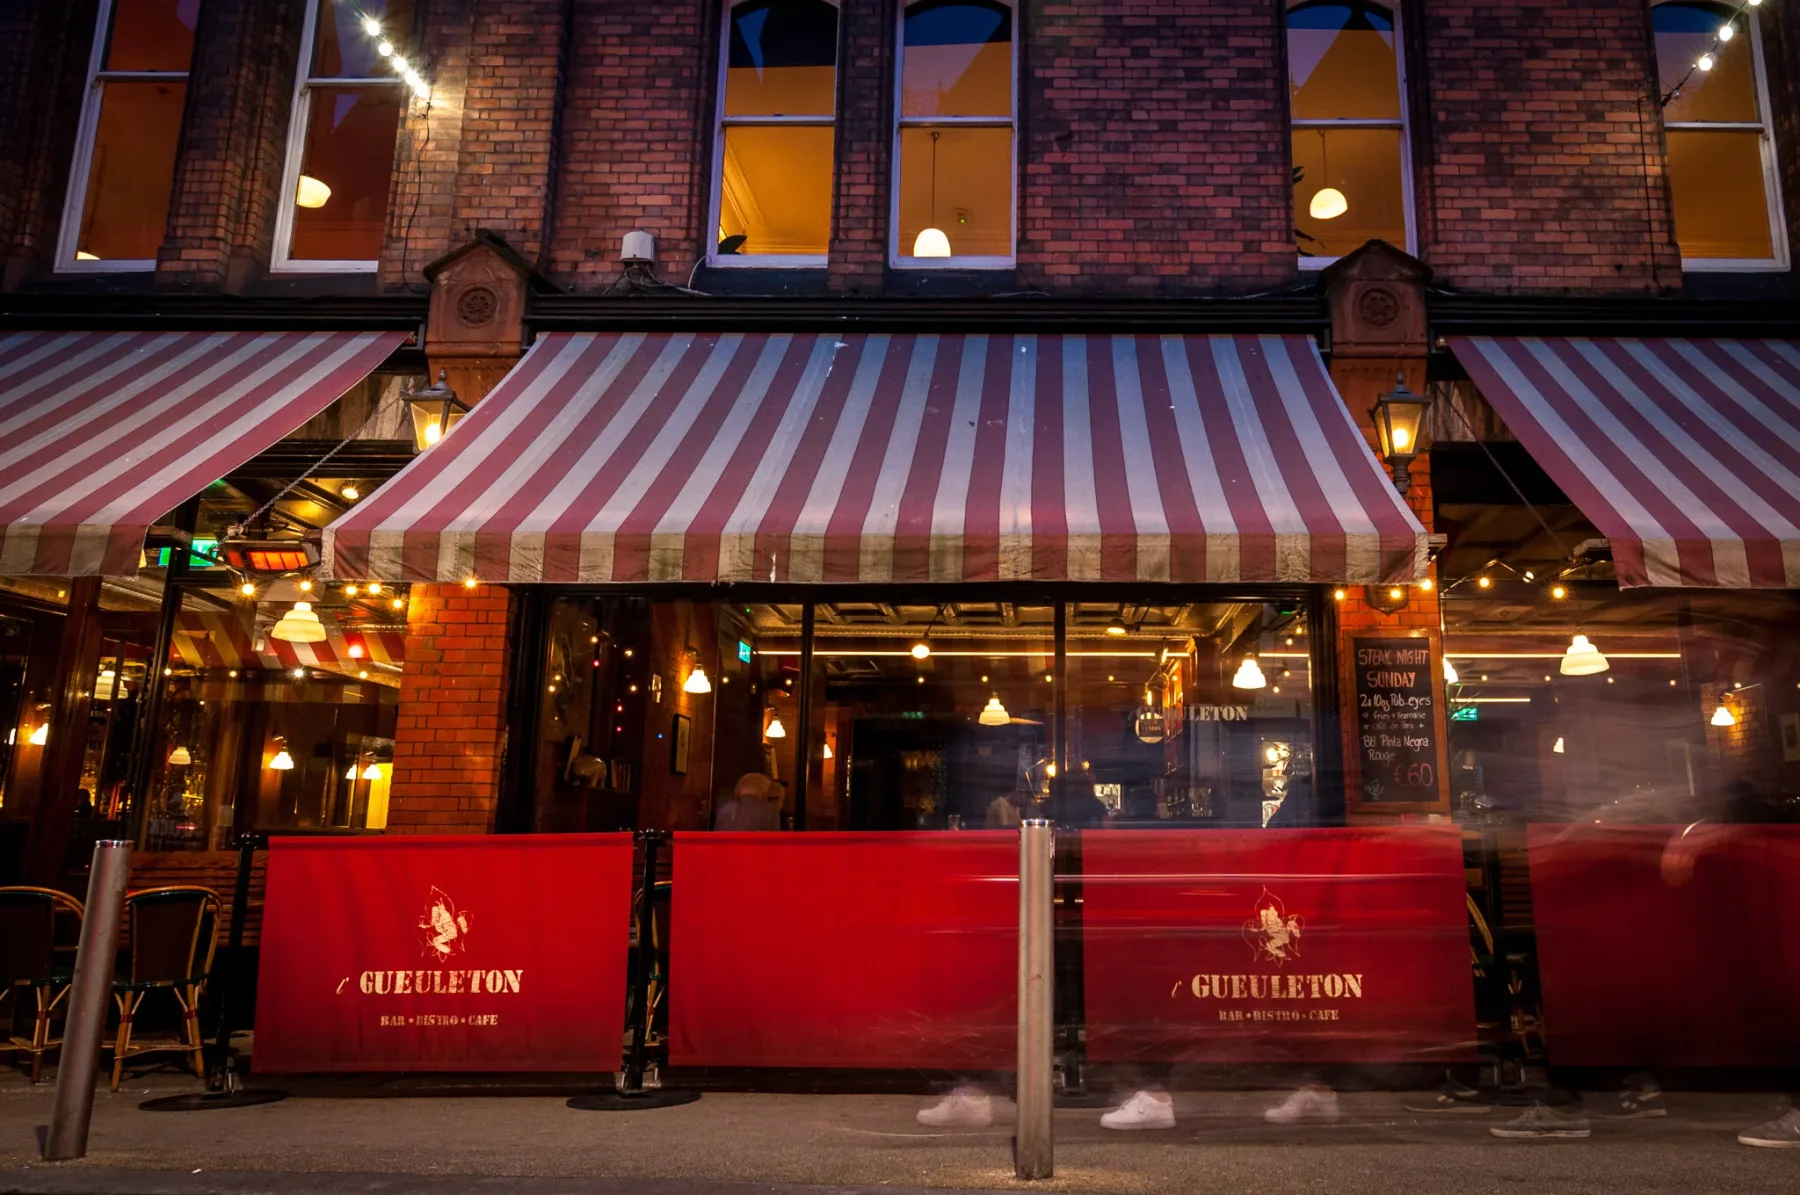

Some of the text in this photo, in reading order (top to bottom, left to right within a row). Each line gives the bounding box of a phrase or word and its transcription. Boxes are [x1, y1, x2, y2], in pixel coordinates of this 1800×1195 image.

[1358, 648, 1429, 665] STEAK NIGHT
[1366, 669, 1416, 688] SUNDAY
[1403, 735, 1429, 752] Negra
[1368, 749, 1395, 767] Rouge
[359, 969, 524, 995] GUEULETON
[1191, 973, 1363, 999] GUEULETON
[380, 1014, 499, 1027] BAR BISTRO CAFE
[1219, 1008, 1339, 1021] BAR BISTRO CAFE
